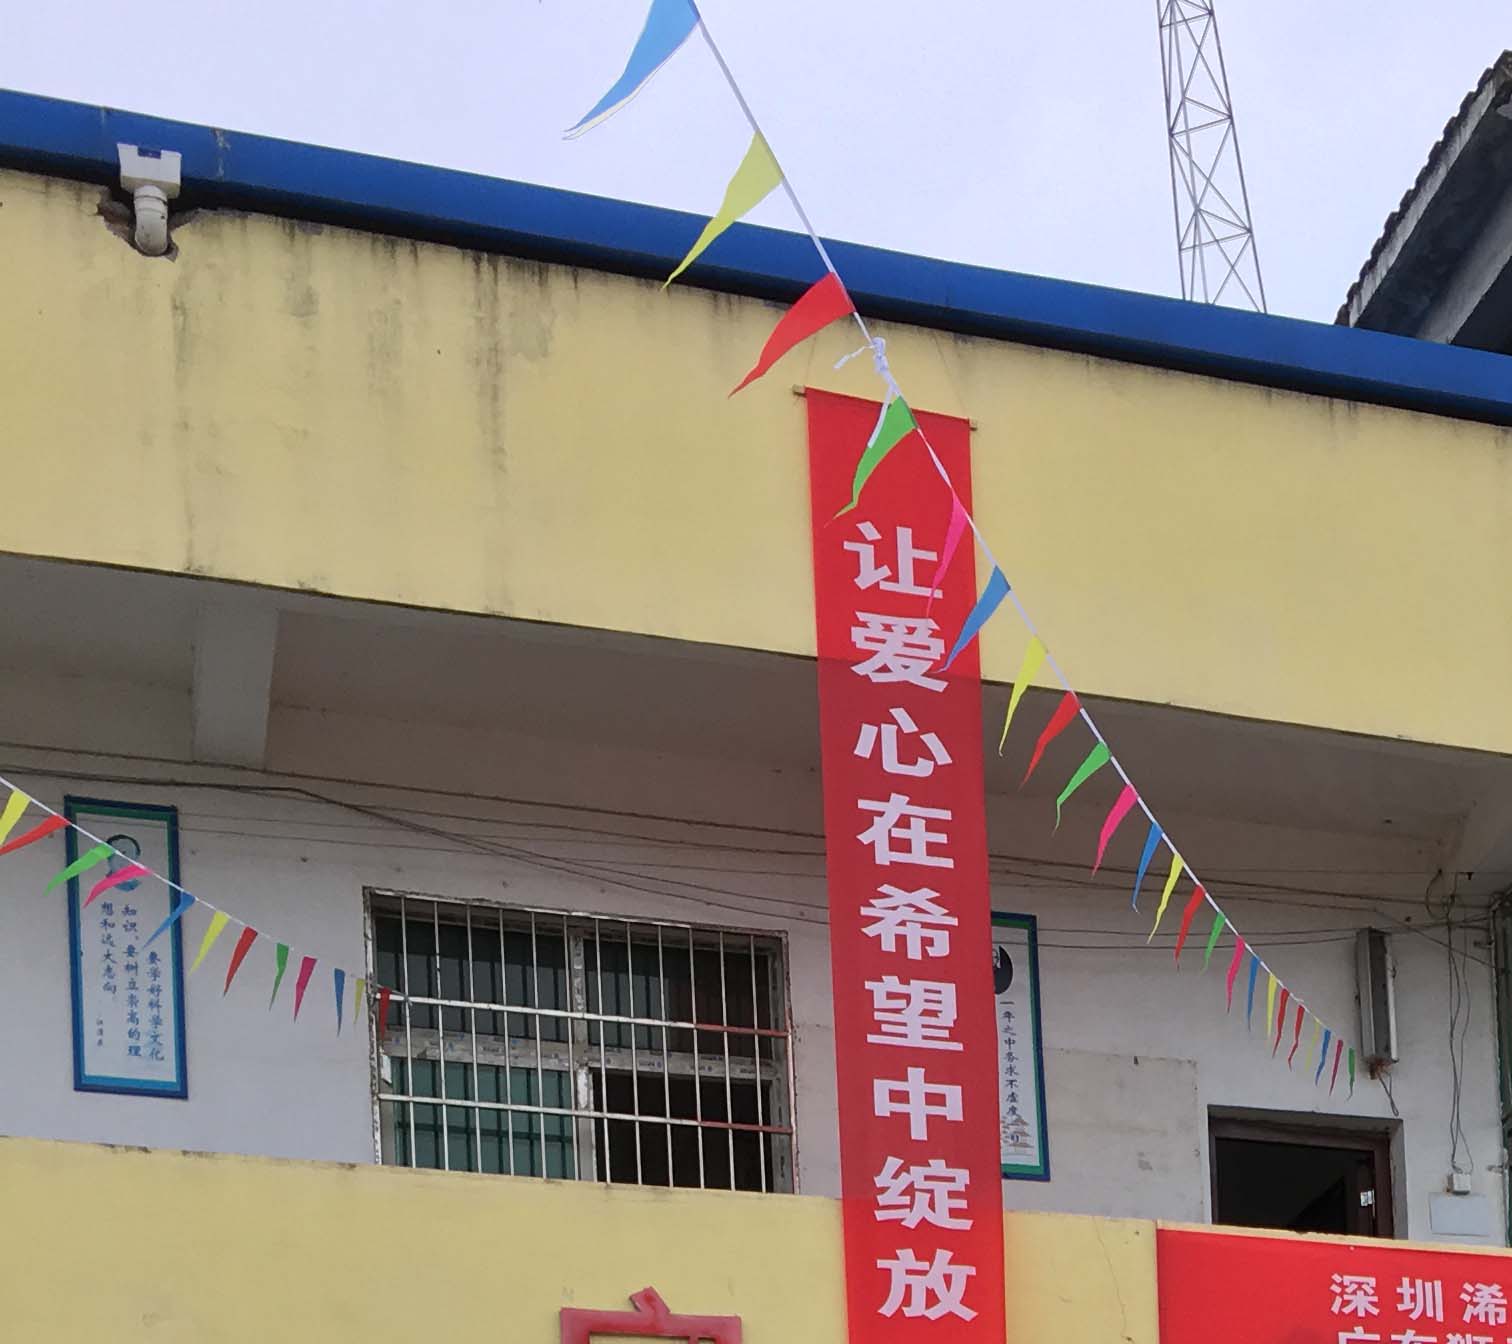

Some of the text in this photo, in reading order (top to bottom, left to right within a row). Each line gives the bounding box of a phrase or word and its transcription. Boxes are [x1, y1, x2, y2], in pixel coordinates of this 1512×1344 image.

[843, 521, 978, 1322] 让爱心在希望中绽放
